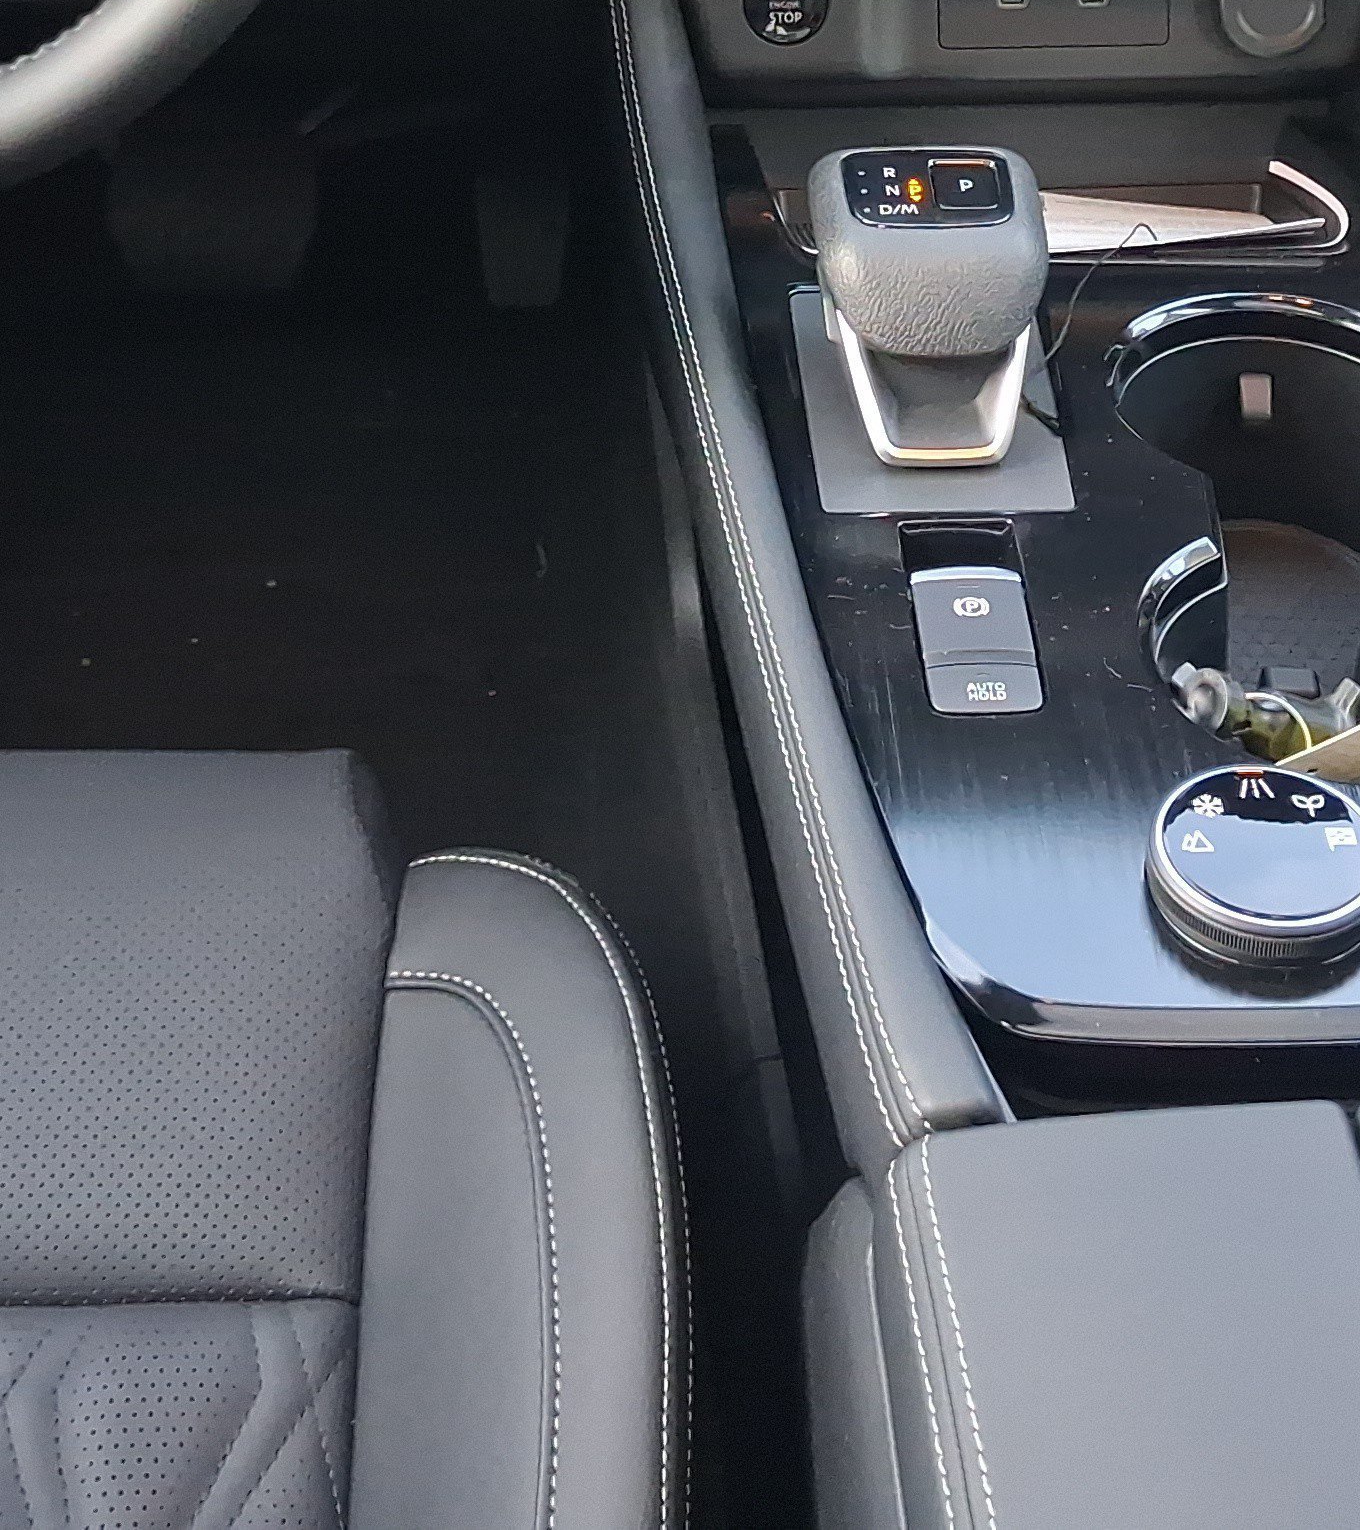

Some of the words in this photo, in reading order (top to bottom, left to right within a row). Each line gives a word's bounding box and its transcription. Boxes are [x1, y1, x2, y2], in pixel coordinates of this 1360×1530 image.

[769, 11, 803, 24] STOP
[882, 167, 897, 179] R
[885, 184, 901, 197] N
[958, 178, 974, 193] P
[877, 204, 920, 215] D/M
[966, 681, 1006, 692] AUTO
[968, 690, 1007, 701] HOLD
